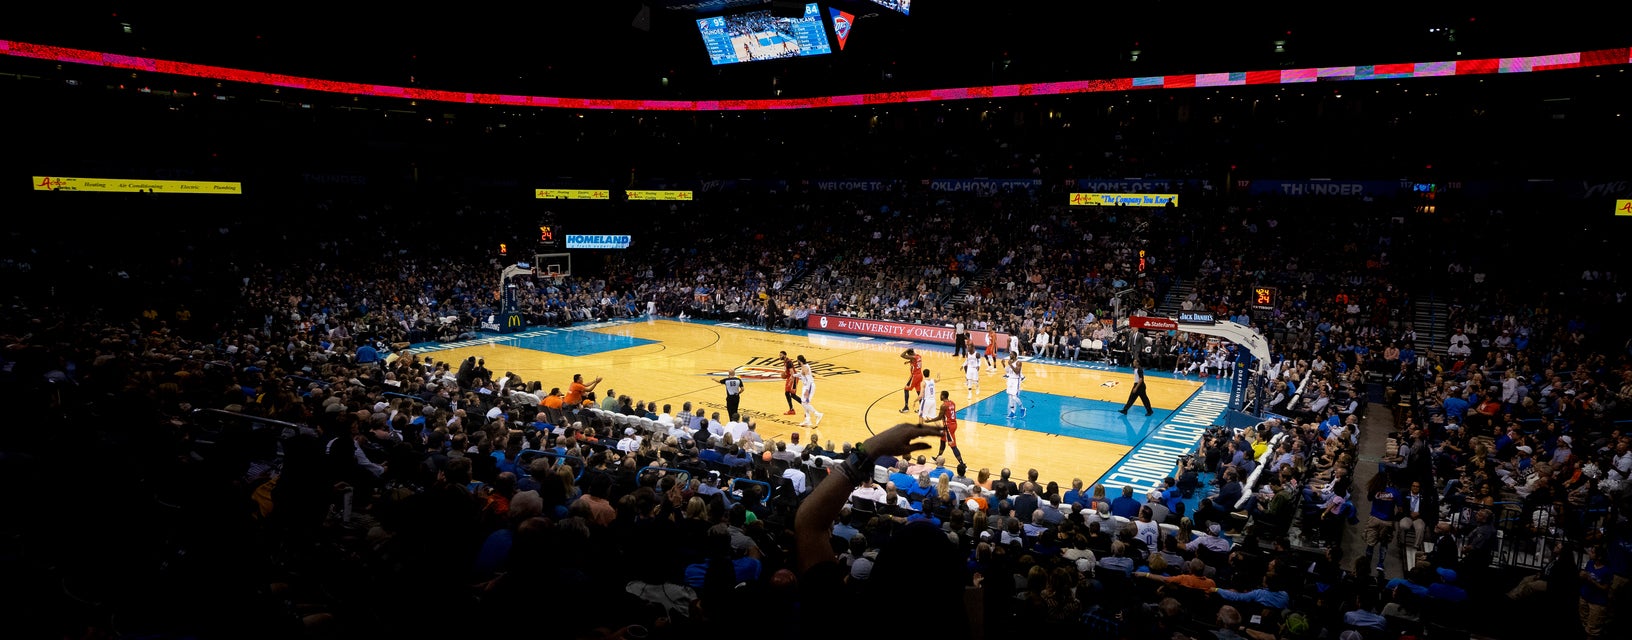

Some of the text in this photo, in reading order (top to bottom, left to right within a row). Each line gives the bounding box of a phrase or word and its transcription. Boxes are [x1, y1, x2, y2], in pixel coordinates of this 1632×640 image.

[805, 5, 818, 14] 84
[713, 18, 725, 27] 95
[818, 182, 868, 191] WELCOME
[931, 182, 1031, 192] OKLAHOMA CITY
[1088, 182, 1129, 193] HOME
[1281, 183, 1364, 196] THUNDER
[1116, 195, 1141, 206] Company
[1143, 195, 1153, 203] You
[541, 232, 552, 241] 24
[567, 235, 629, 244] HOMELAND
[1258, 295, 1269, 304] 24
[1179, 312, 1214, 322] JACK DANIEL'S
[480, 321, 500, 332] SPALDING
[838, 320, 847, 328] The
[848, 320, 906, 335] UNIVERSITY
[906, 327, 914, 336] of
[1234, 369, 1244, 406] DRAFTKINGS
[1151, 423, 1206, 446] CITY
[1101, 443, 1191, 495] THUNDER
[1146, 534, 1152, 545] 0
